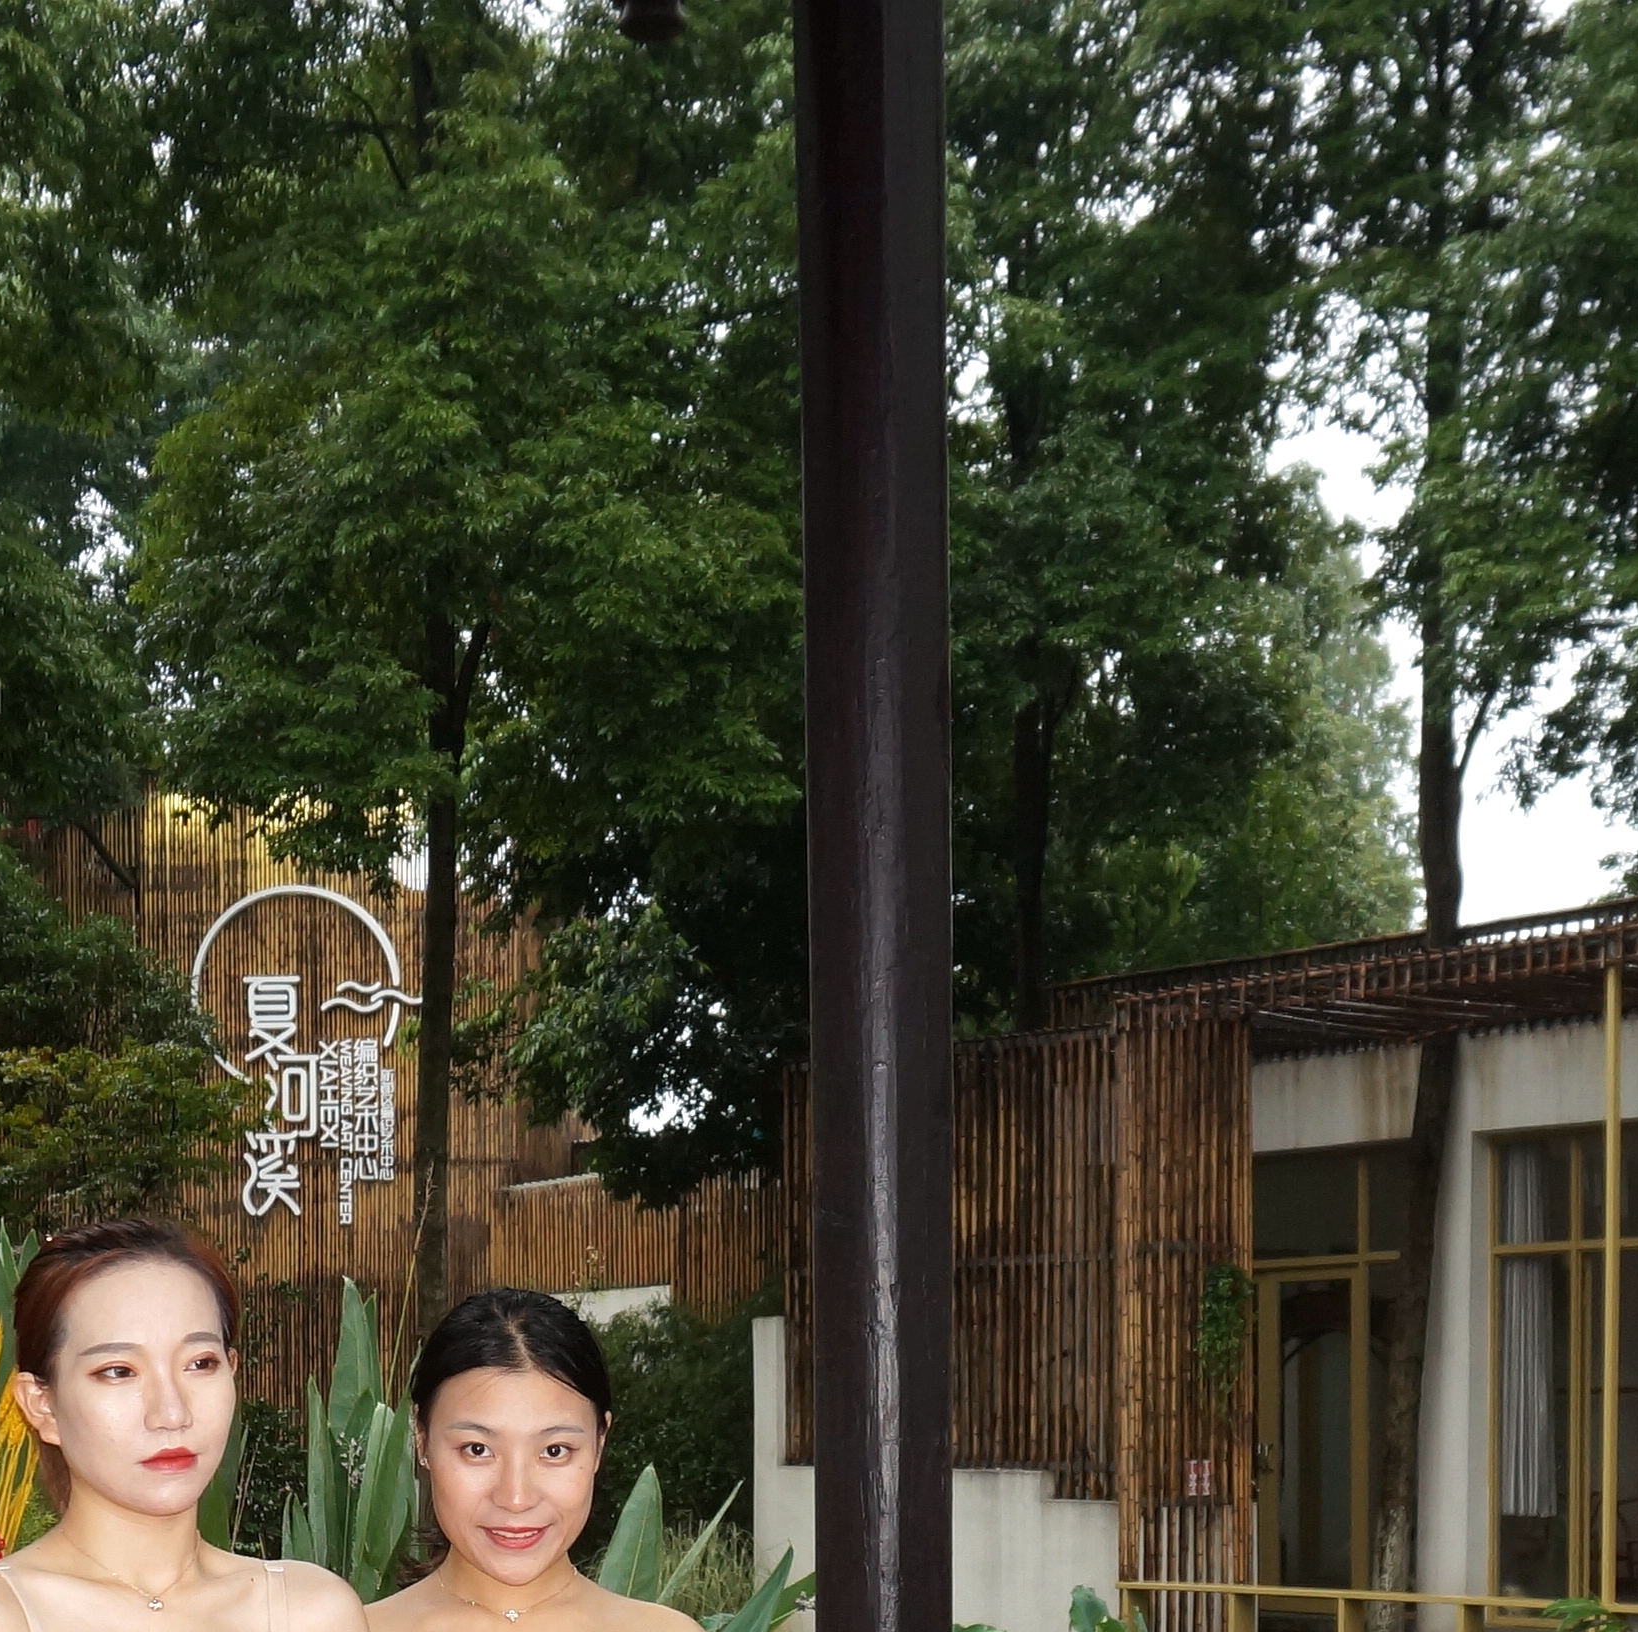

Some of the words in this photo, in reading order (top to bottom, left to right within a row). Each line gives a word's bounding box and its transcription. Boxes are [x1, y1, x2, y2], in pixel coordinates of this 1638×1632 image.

[319, 1040, 339, 1148] XIAHEXI
[340, 1038, 353, 1115] WEAVING
[353, 1037, 378, 1180] 编织艺术中心
[341, 1119, 353, 1153] ART
[340, 1157, 352, 1225] CENTER
